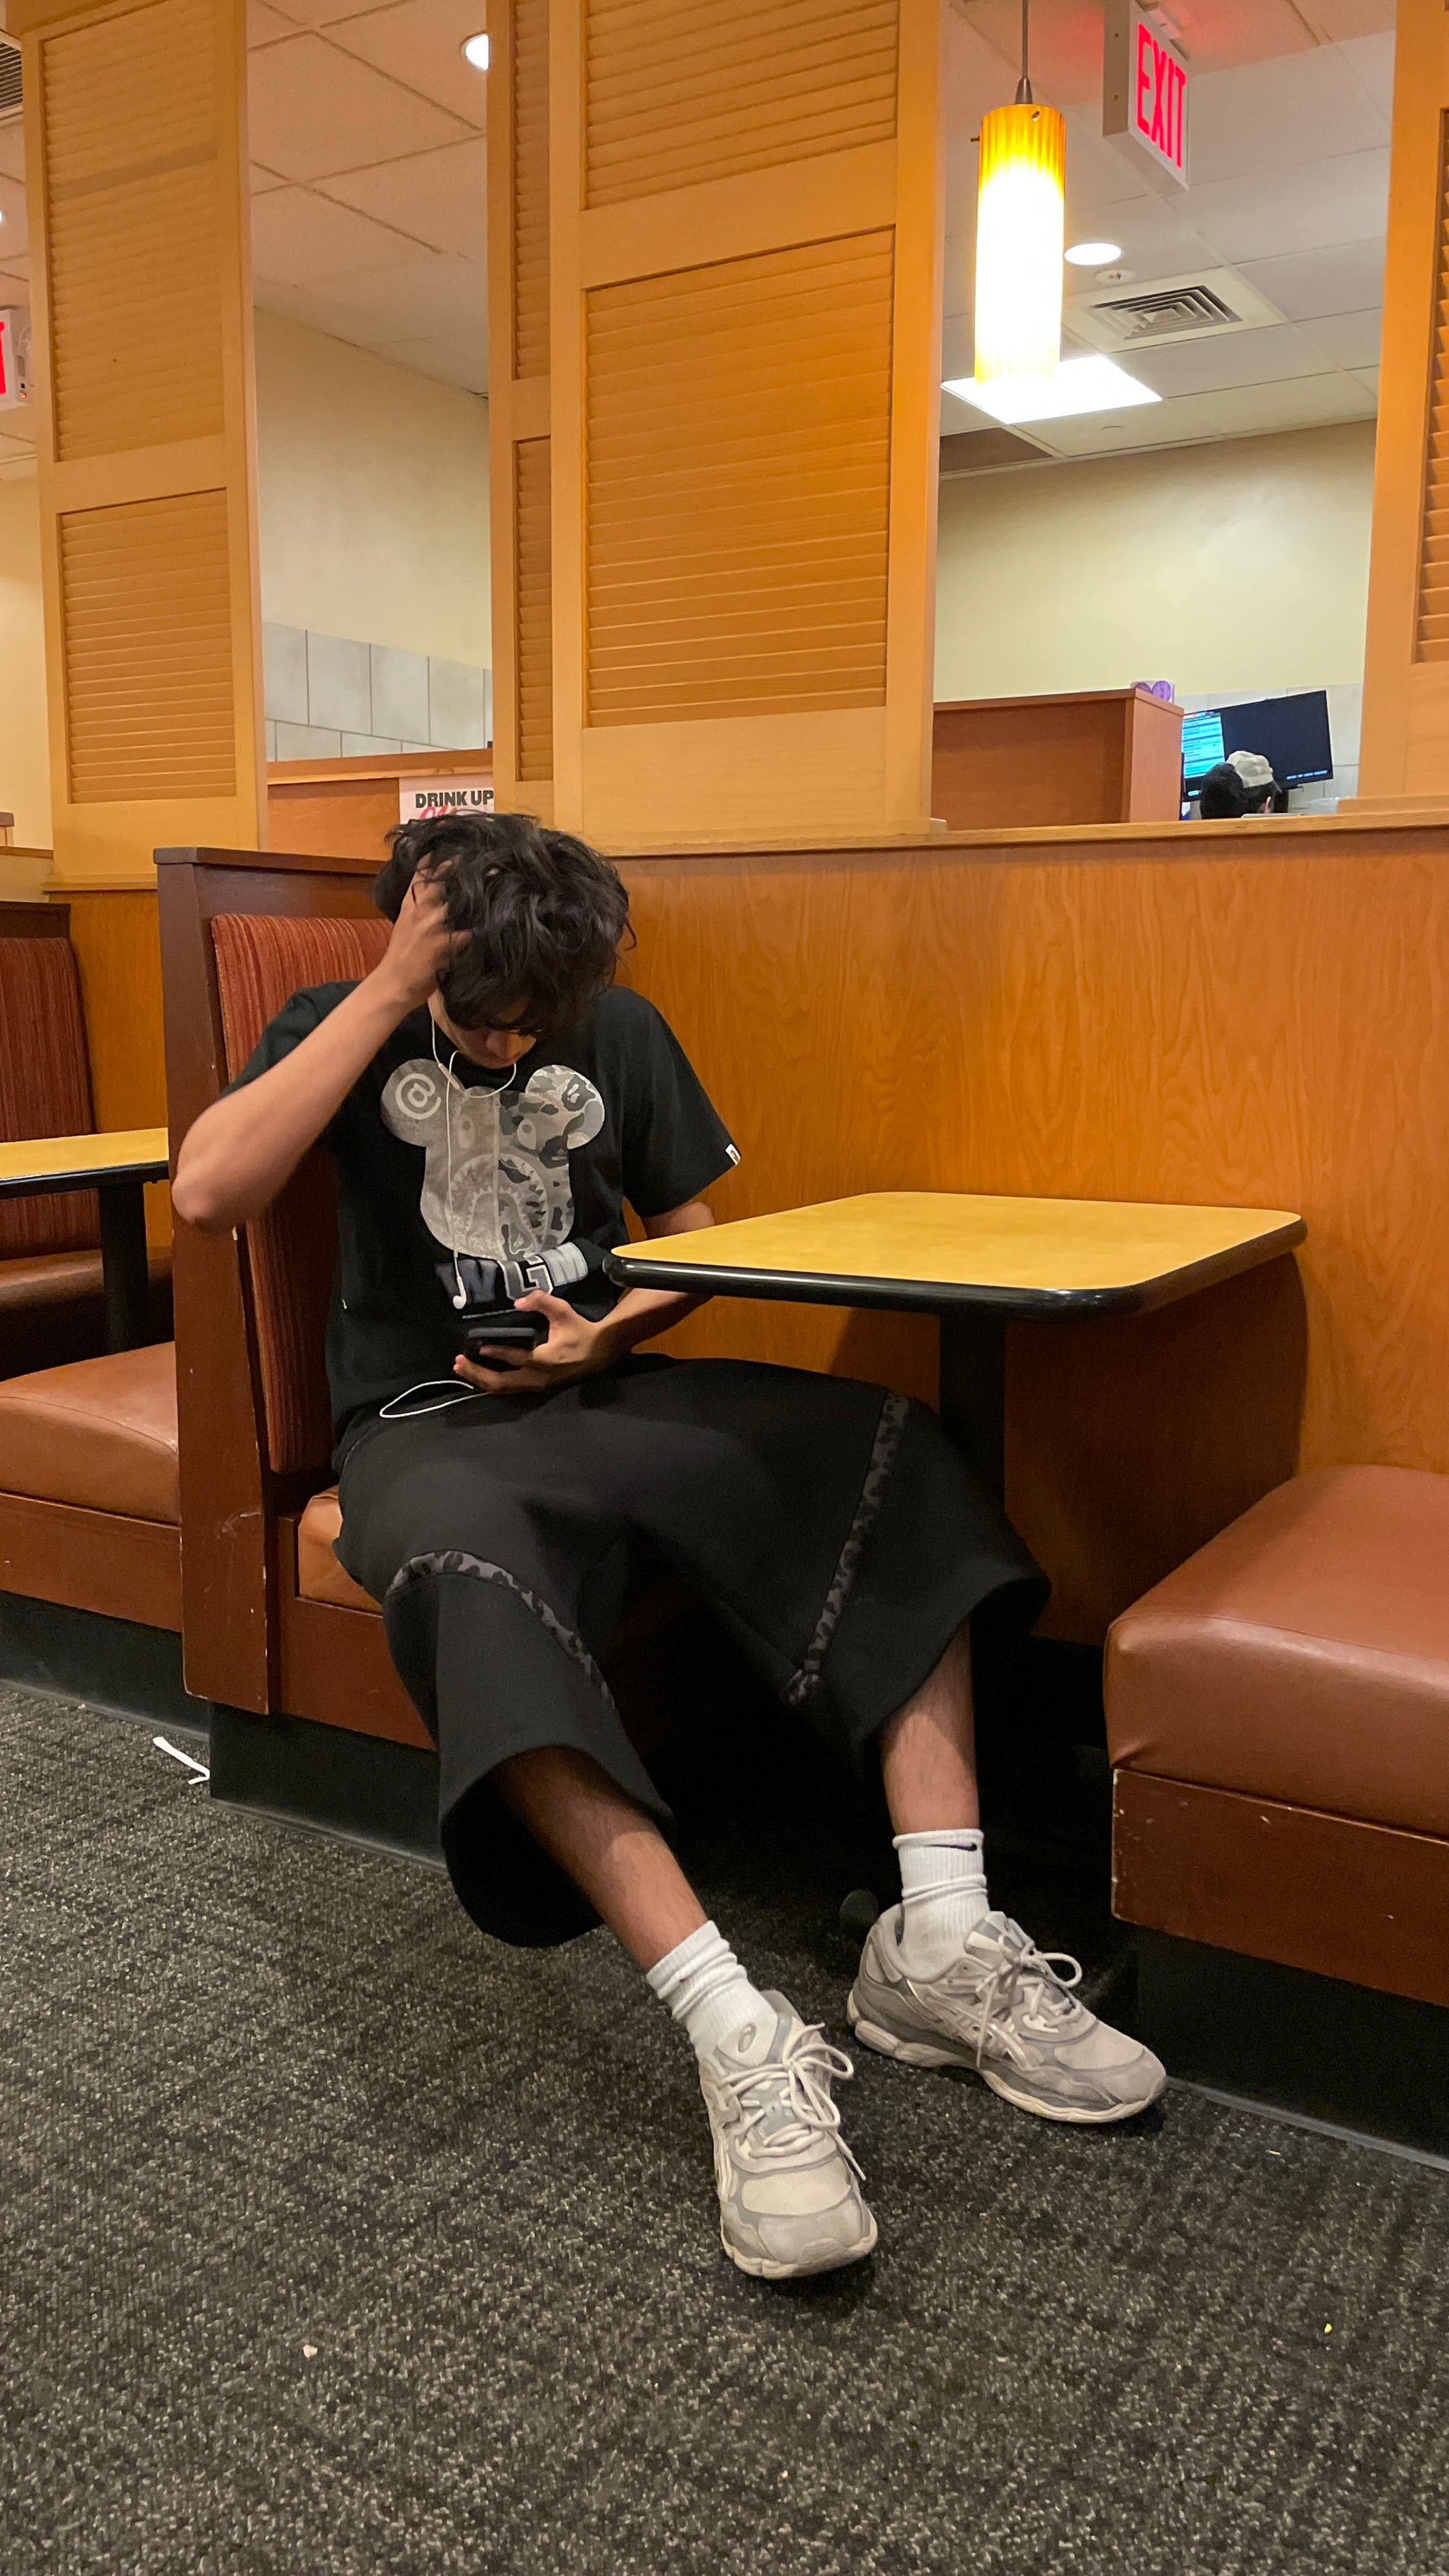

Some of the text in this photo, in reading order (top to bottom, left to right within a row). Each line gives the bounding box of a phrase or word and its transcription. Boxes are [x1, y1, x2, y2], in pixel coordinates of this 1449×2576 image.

[1137, 21, 1186, 169] EXIT
[415, 790, 494, 808] DRINK UP
